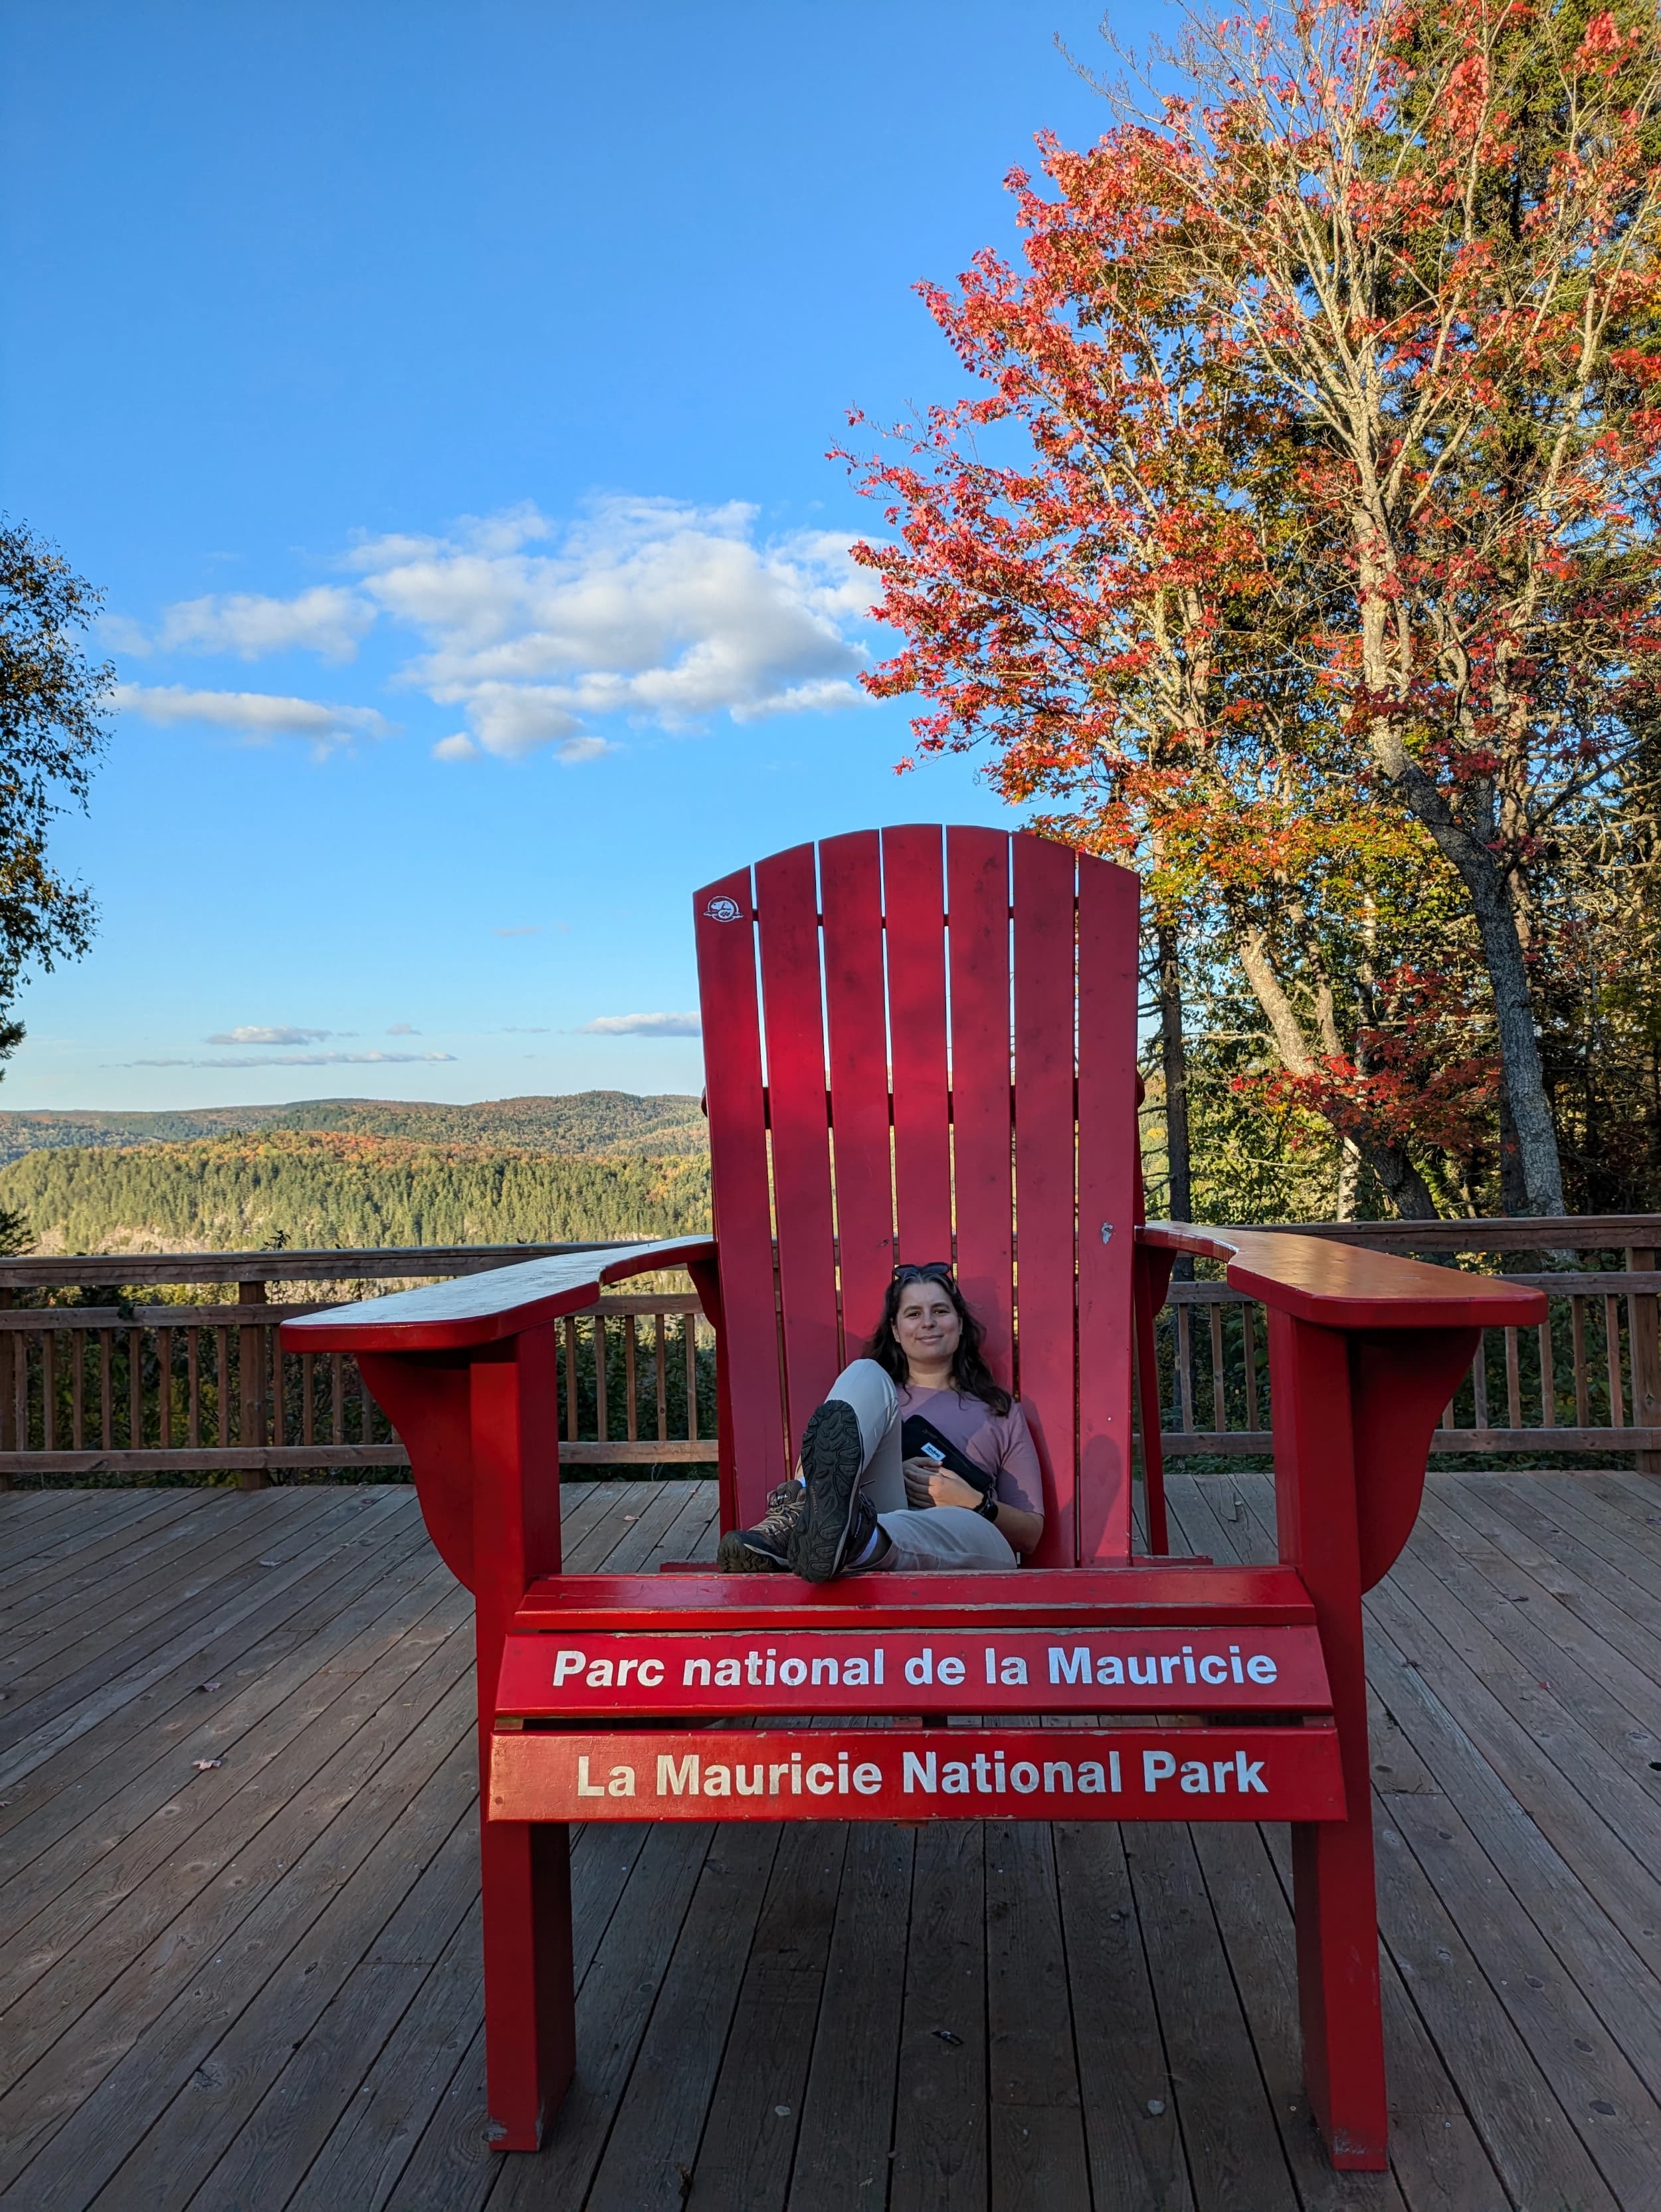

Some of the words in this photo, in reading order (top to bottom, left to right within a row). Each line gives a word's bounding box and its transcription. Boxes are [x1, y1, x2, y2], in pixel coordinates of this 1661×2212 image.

[552, 1650, 665, 1687] Parc
[682, 1649, 884, 1686] national
[904, 1648, 966, 1686] de
[985, 1647, 1028, 1685] la
[1048, 1645, 1278, 1685] Mauricie
[577, 1754, 636, 1797] La
[655, 1752, 882, 1797] Mauricie
[902, 1750, 1122, 1794] National
[1143, 1750, 1269, 1793] Park
